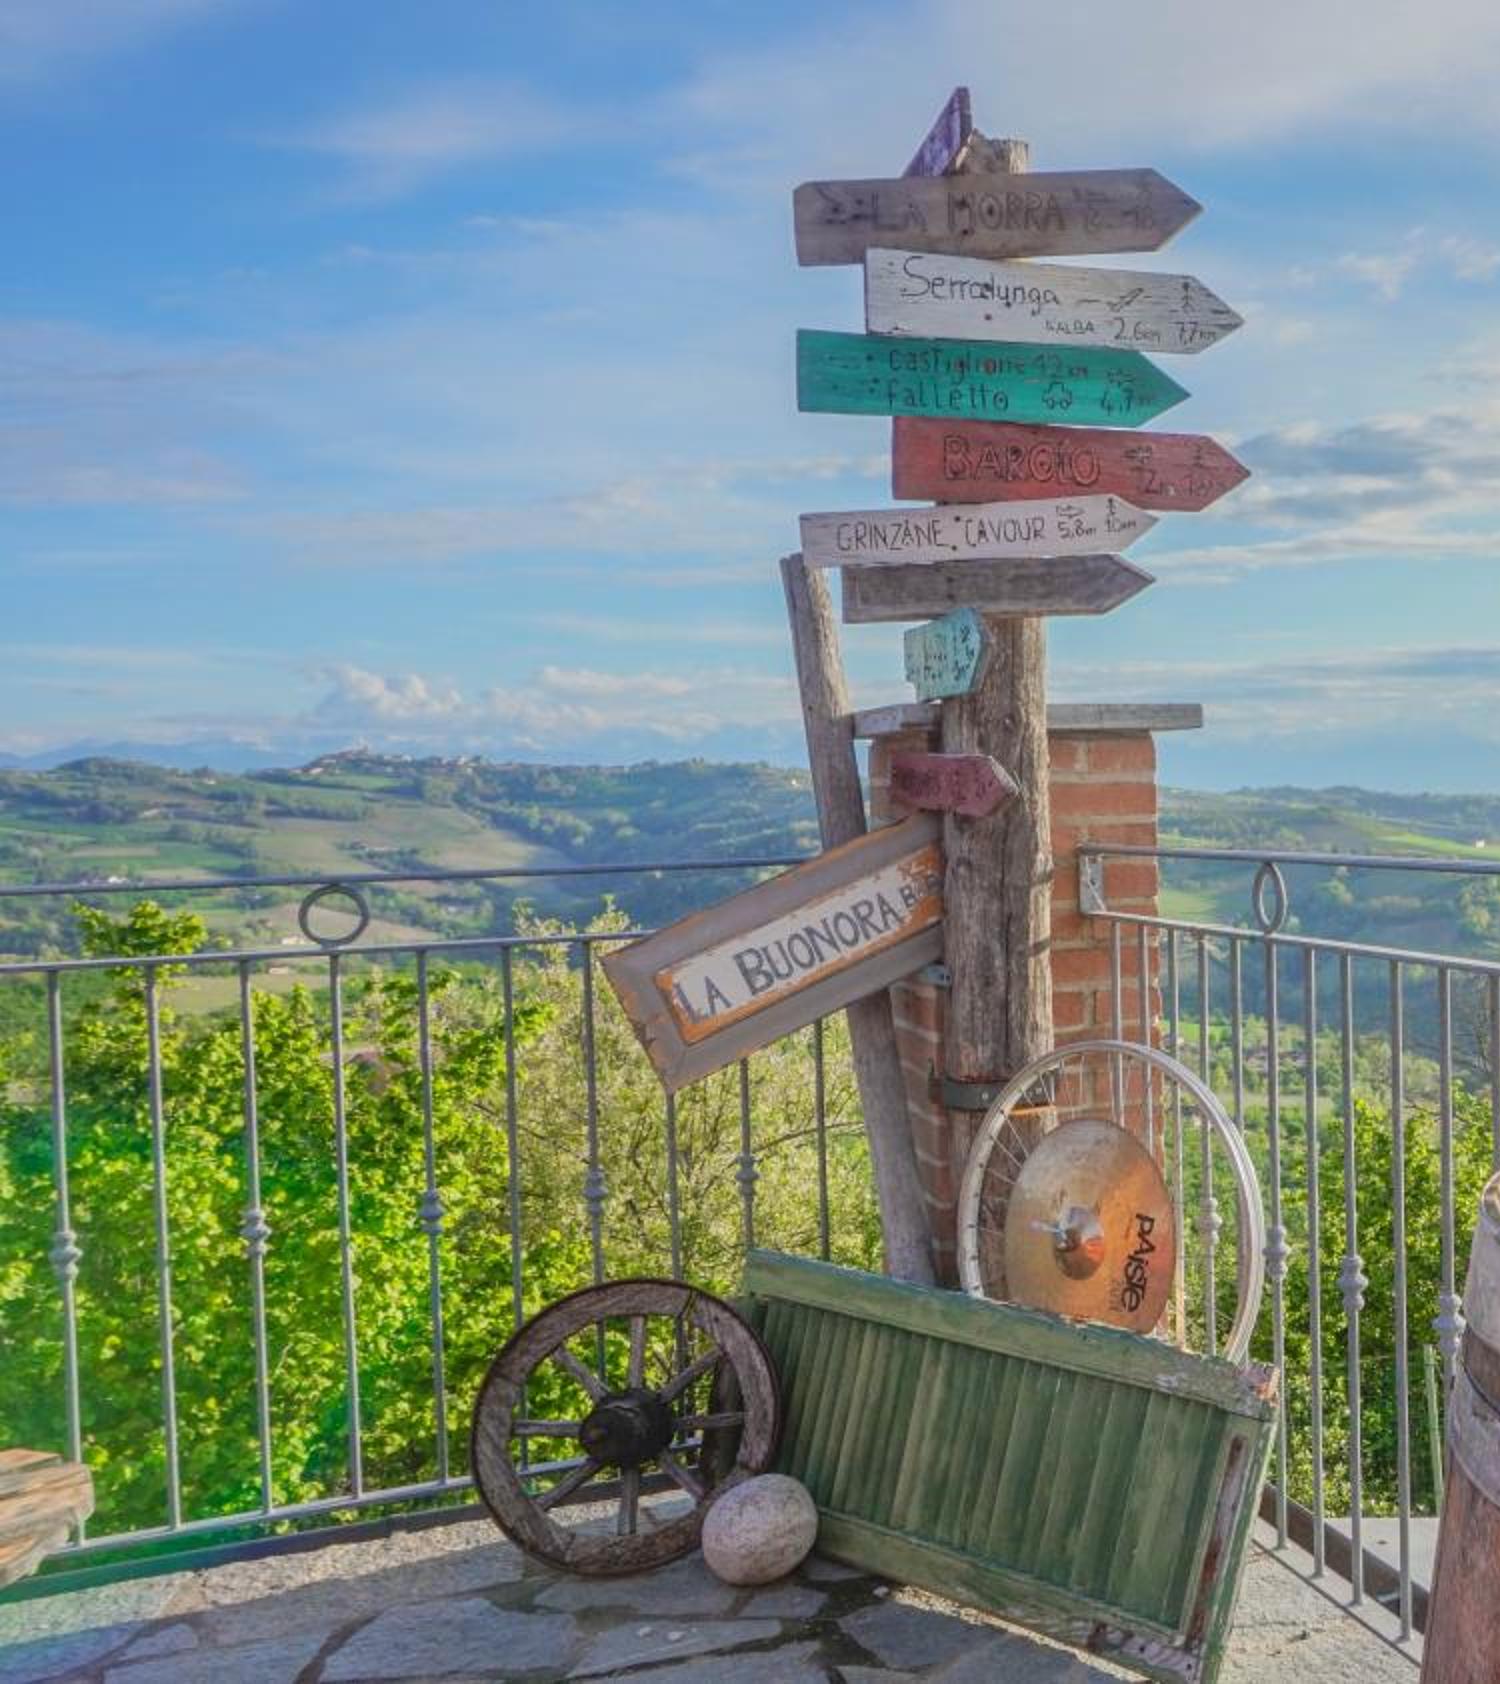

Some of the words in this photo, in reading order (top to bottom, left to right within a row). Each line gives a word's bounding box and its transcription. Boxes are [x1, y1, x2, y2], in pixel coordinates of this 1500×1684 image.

[964, 517, 1046, 547] CAVOUR
[673, 974, 733, 1024] LA
[732, 891, 903, 997] BUONORA
